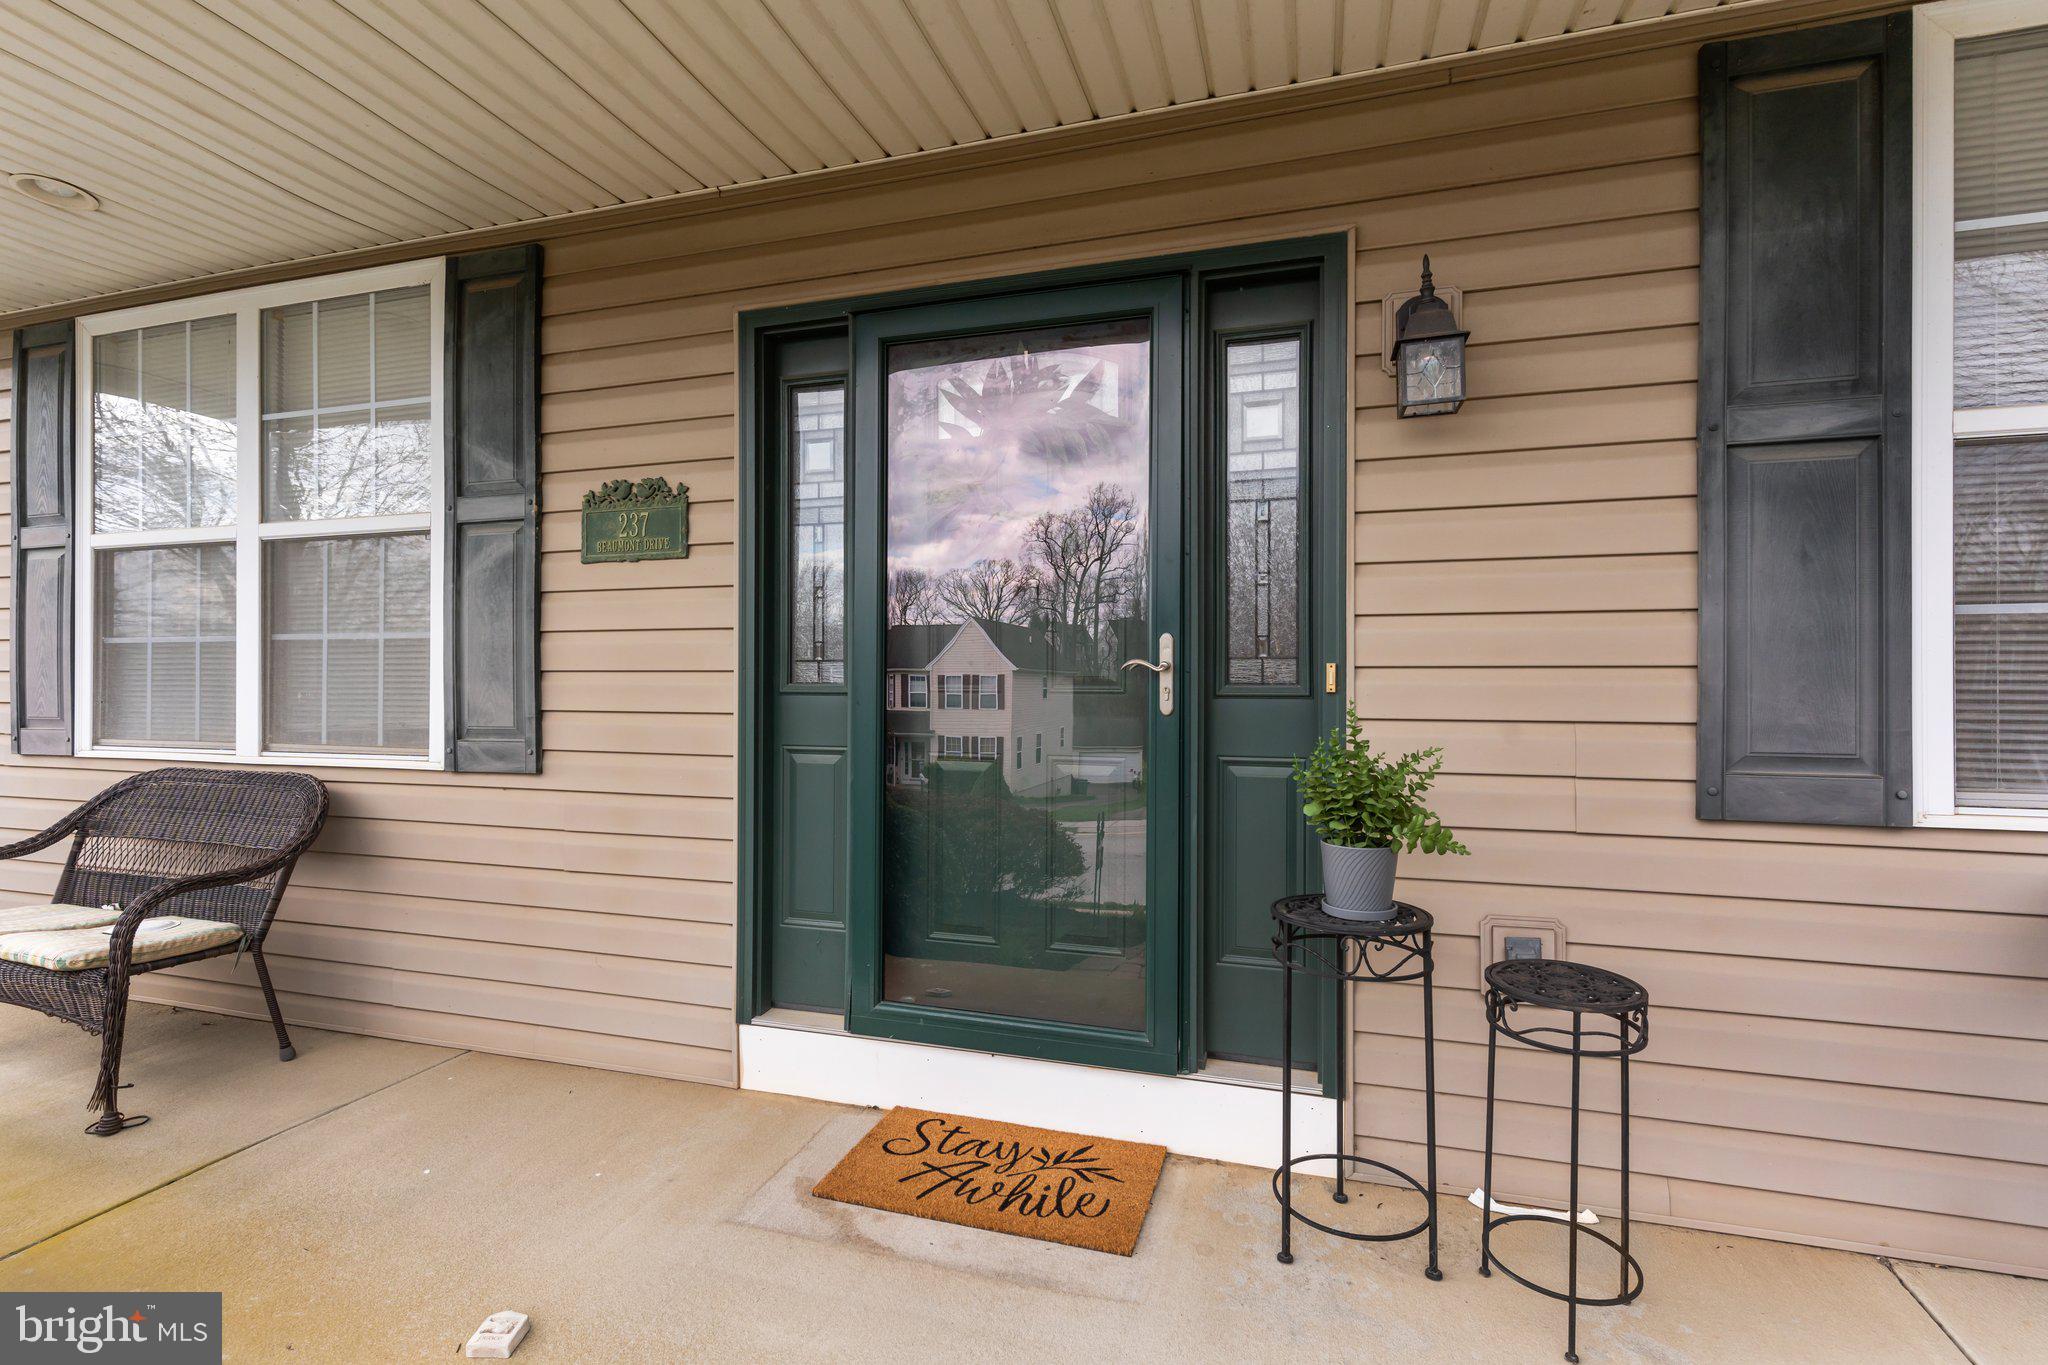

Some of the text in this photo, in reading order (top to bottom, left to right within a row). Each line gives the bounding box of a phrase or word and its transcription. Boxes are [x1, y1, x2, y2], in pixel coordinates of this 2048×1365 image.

[619, 512, 649, 538] 237
[597, 537, 670, 553] BEAUMONT DRIVE
[882, 1118, 1036, 1173] Stay
